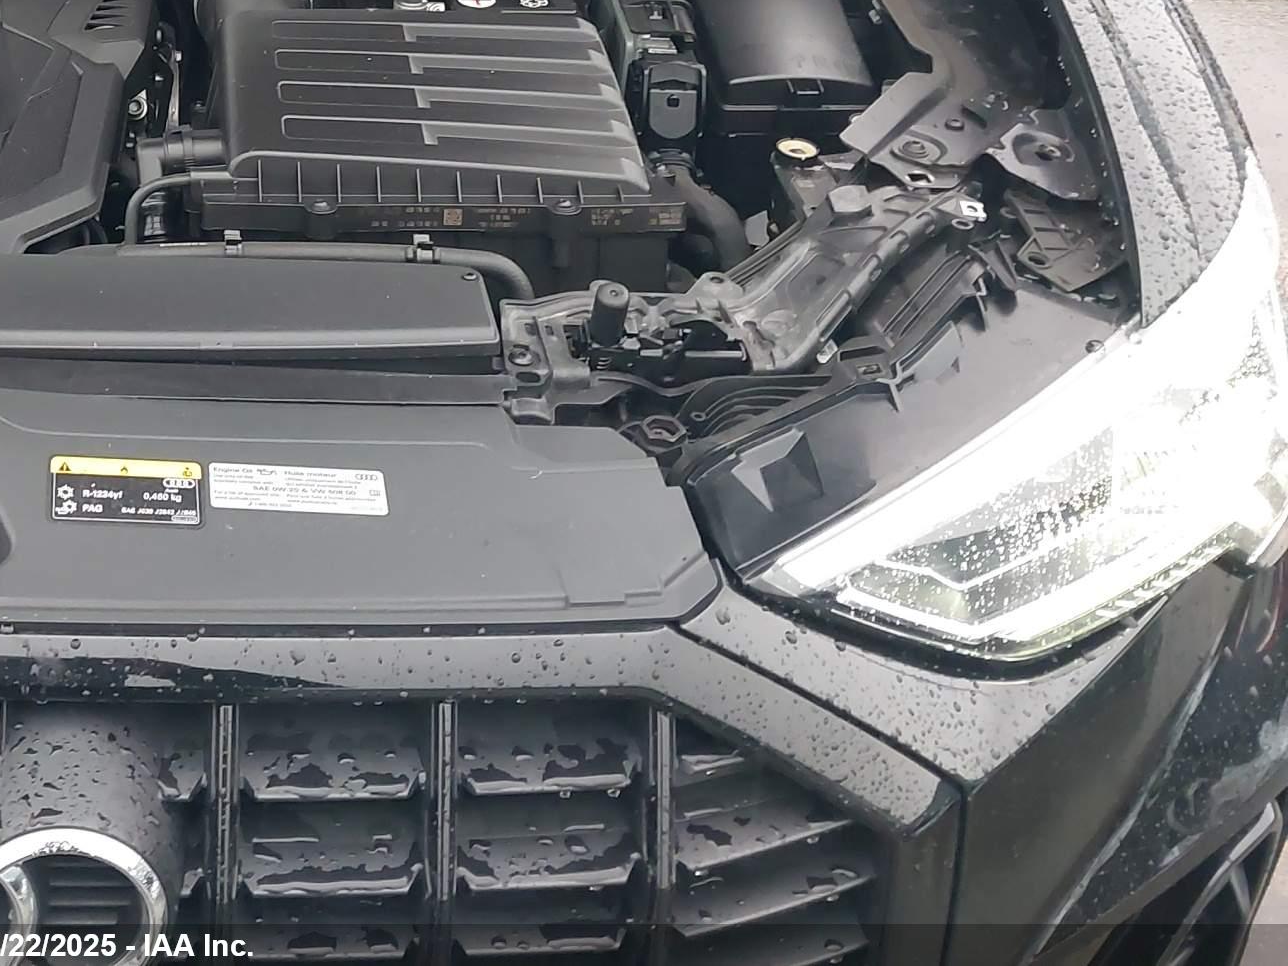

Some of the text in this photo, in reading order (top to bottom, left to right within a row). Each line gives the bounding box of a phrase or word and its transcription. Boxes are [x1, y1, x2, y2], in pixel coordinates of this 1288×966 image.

[82, 489, 124, 500] R-1234yf
[170, 493, 182, 503] kg
[82, 503, 103, 513] PAG
